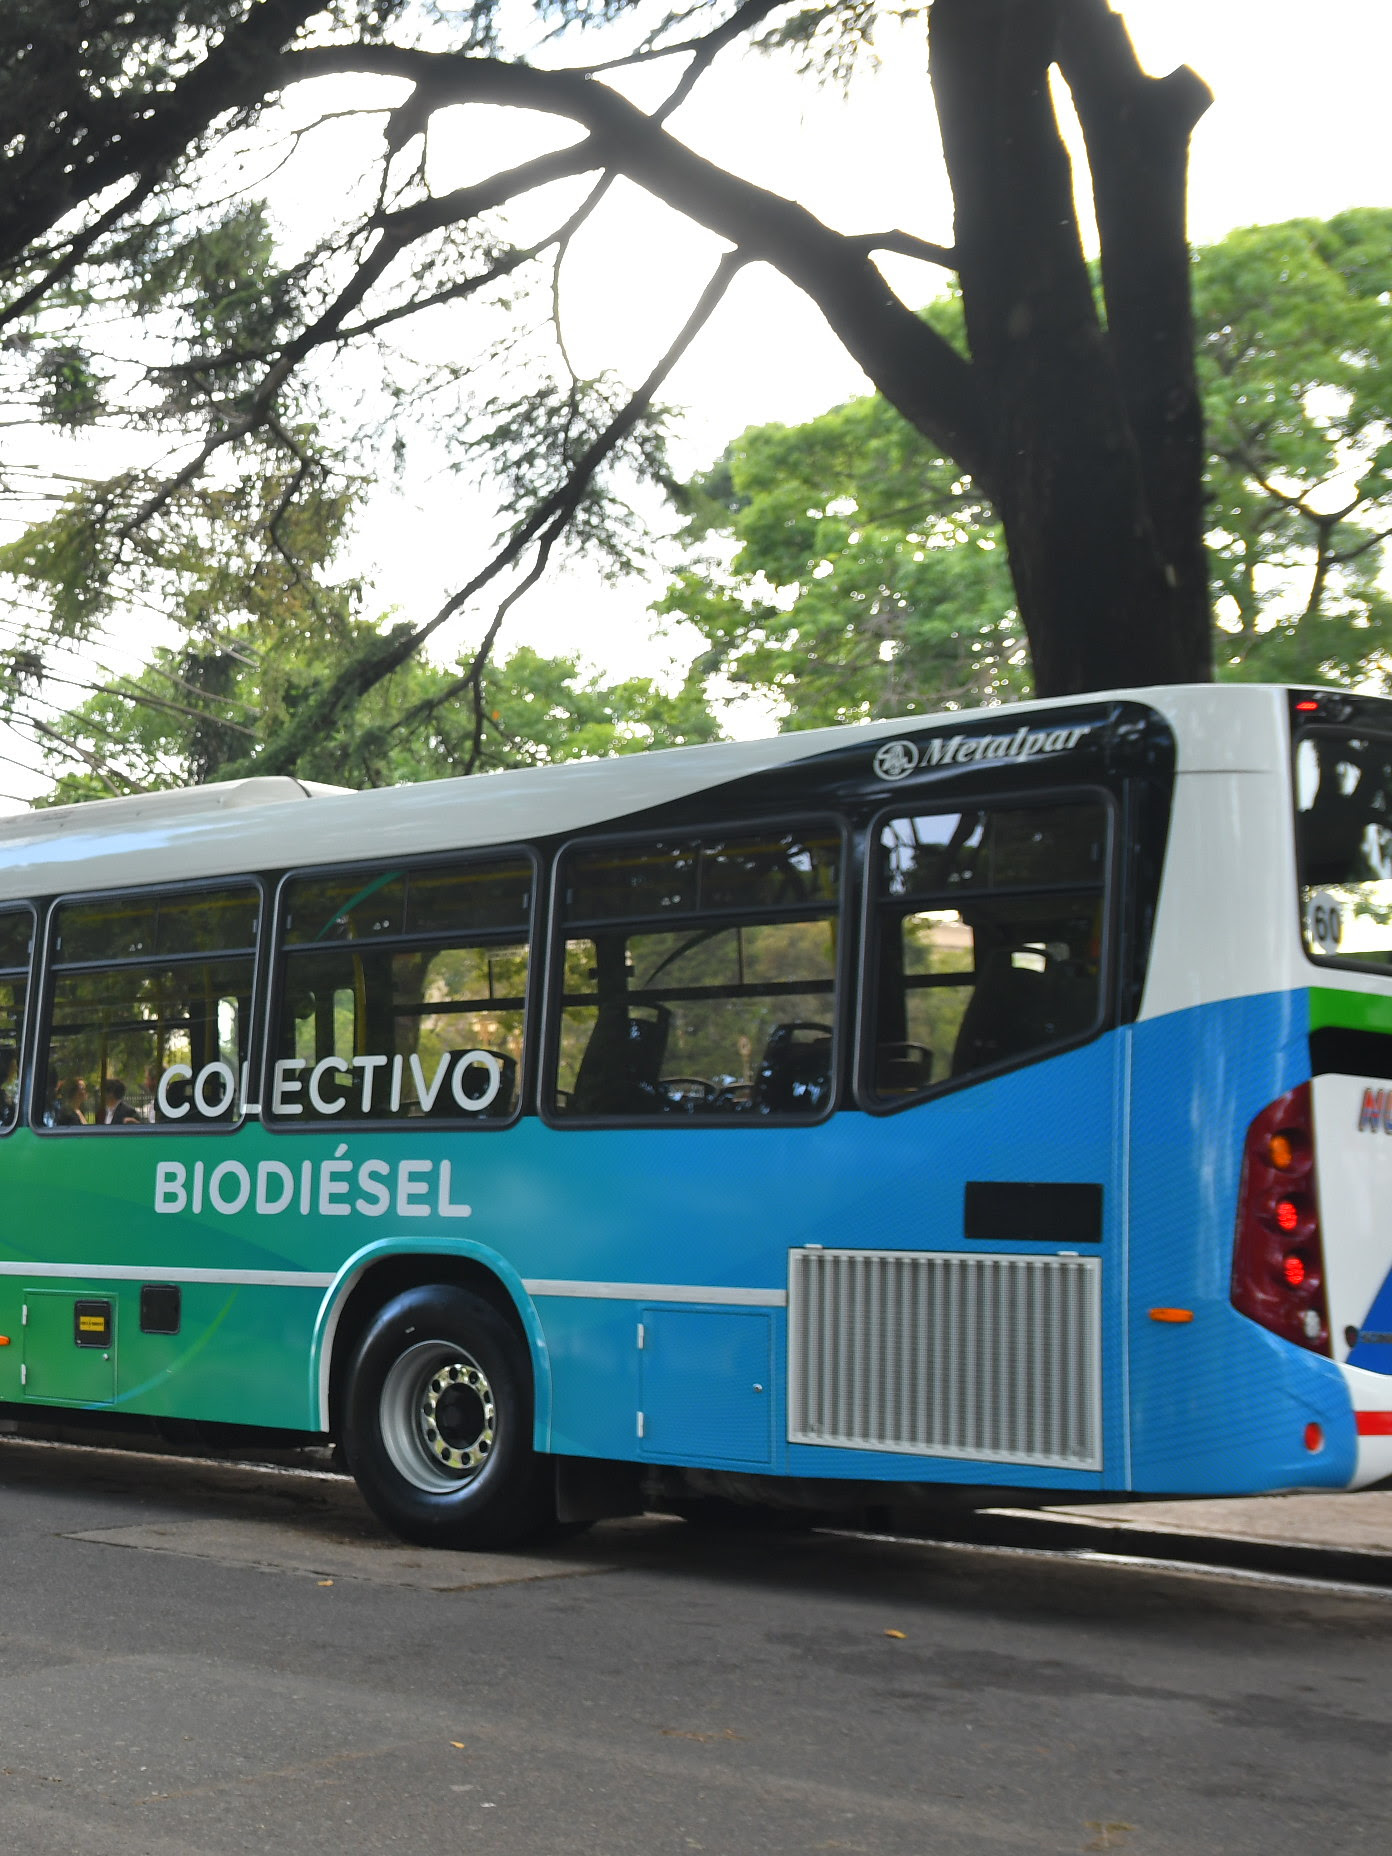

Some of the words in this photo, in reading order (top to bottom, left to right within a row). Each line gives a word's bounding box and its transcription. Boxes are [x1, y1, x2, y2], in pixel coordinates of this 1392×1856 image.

[918, 725, 1092, 768] Metalpar
[1314, 904, 1341, 943] 60
[157, 1050, 501, 1119] COLECTIVO
[154, 1143, 472, 1218] BIODIÉSEL
